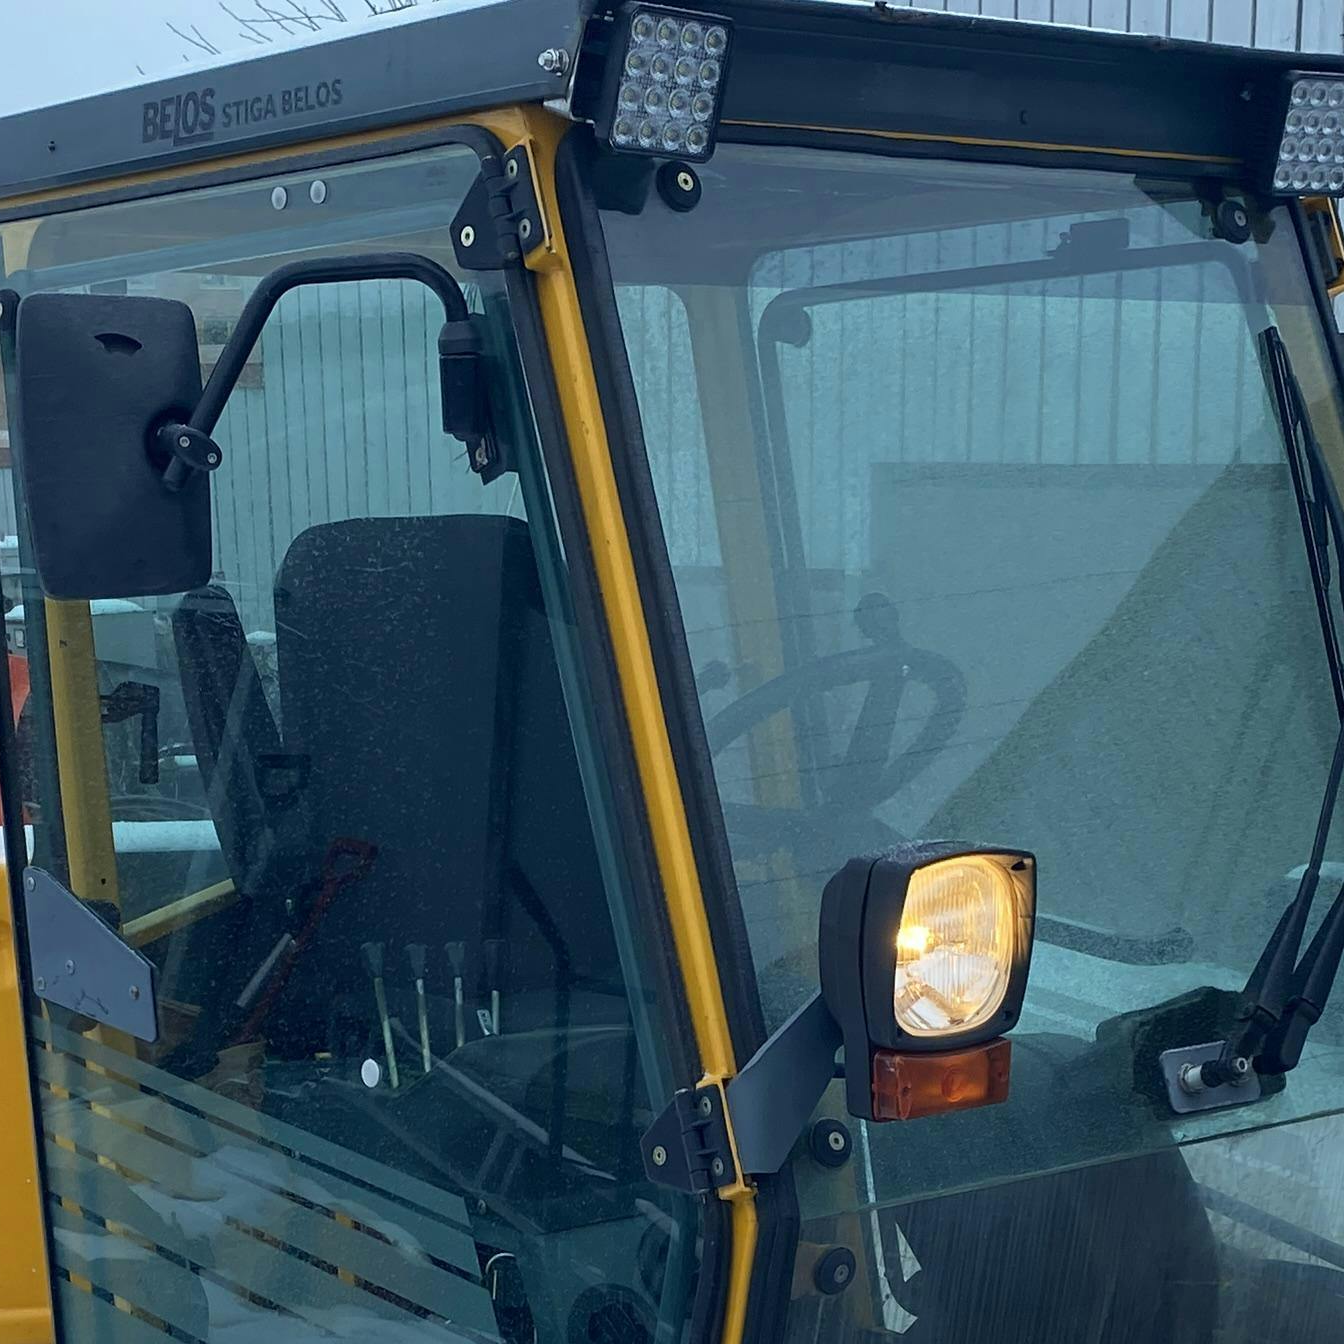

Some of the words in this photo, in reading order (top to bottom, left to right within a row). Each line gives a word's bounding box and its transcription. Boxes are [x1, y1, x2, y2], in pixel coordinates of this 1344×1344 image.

[142, 88, 216, 147] BELOS
[222, 94, 277, 128] STIGA
[281, 78, 344, 116] BELOS
